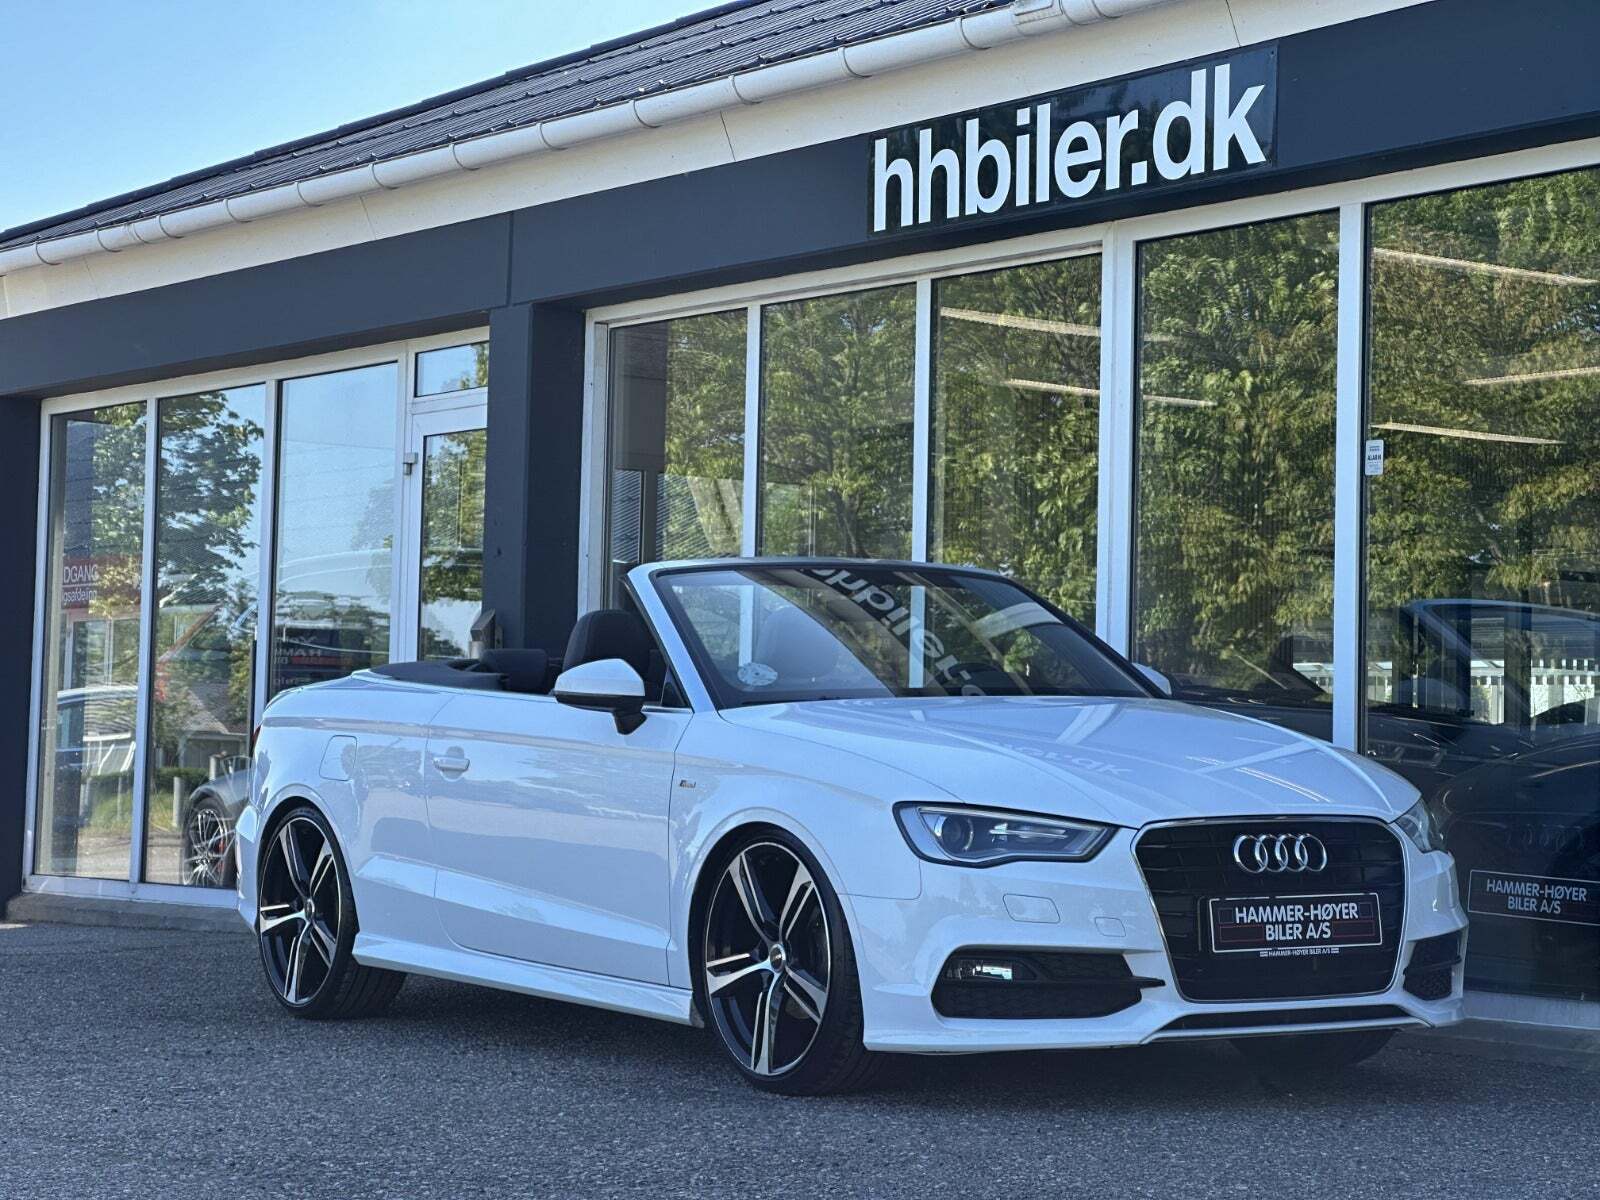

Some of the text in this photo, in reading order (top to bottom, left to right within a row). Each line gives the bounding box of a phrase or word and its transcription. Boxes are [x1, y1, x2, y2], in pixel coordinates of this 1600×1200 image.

[873, 63, 1267, 232] hhbiler.dk
[1486, 879, 1588, 901] HAMMER-HØYER
[1235, 903, 1359, 923] HAMMER-HØYER
[1507, 896, 1561, 914] BILER A/S
[1265, 922, 1331, 941] BILER A/S
